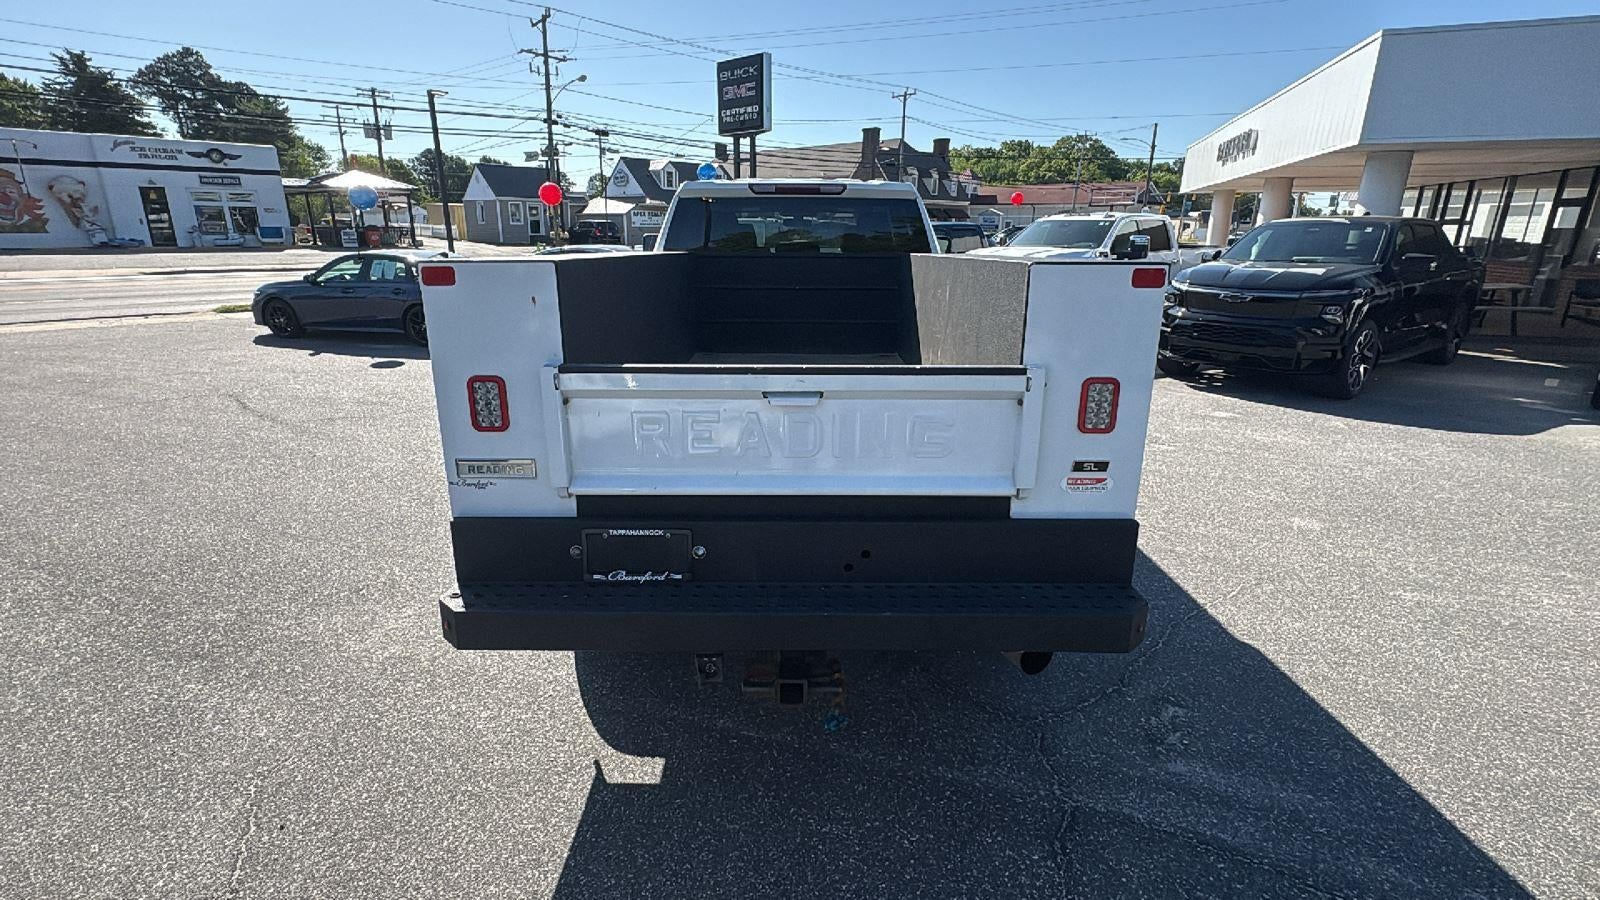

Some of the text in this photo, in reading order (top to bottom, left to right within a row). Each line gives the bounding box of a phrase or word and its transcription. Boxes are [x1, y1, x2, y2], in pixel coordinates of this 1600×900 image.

[720, 65, 758, 81] BUICK
[722, 82, 756, 101] GMC
[721, 105, 759, 117] CERTIFIED
[138, 153, 178, 161] PARLOR
[148, 147, 184, 155] CREAM
[630, 409, 955, 459] READING
[467, 465, 524, 475] READING
[1083, 463, 1099, 471] SL
[608, 569, 669, 584] Bareford
